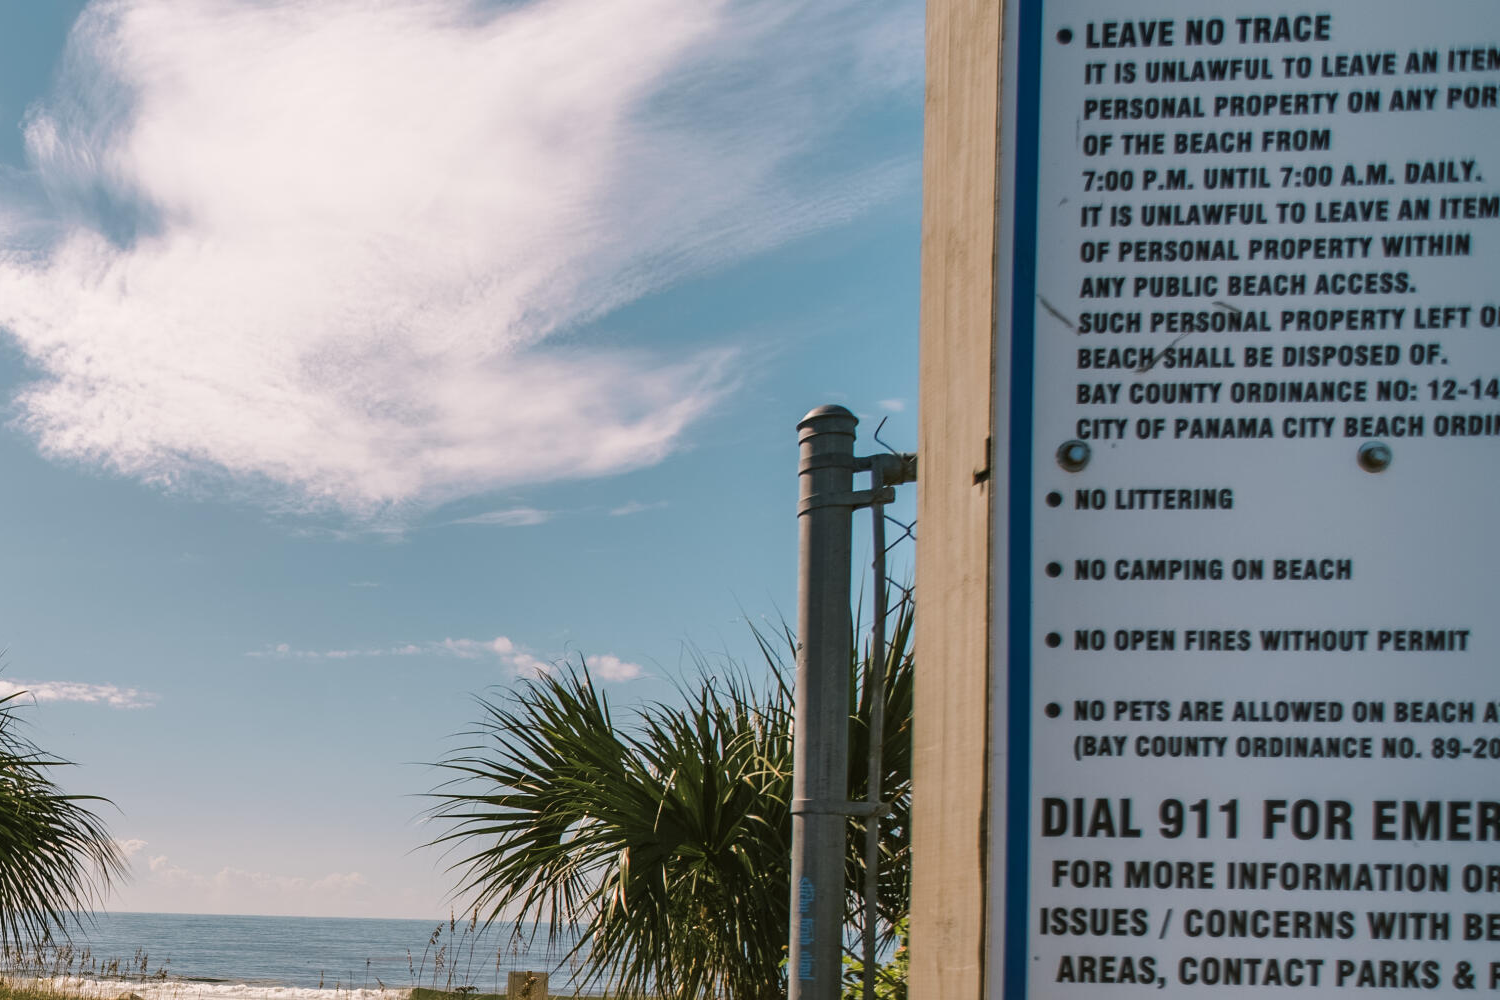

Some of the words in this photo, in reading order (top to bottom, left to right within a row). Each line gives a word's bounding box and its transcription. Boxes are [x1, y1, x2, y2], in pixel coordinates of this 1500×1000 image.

[1086, 20, 1174, 48] LEAVE
[1186, 18, 1225, 45] NO
[1236, 14, 1332, 42] TRACE
[1083, 134, 1113, 156] OF
[1121, 133, 1165, 154] THE
[1174, 131, 1253, 153] BEACH
[1262, 129, 1332, 151] FROM
[1082, 170, 1134, 191] 7:00
[1142, 168, 1194, 190] P.M.
[1204, 167, 1271, 189] UNTIL
[1280, 165, 1334, 187] 7:00
[1341, 163, 1395, 185] A.M.
[1405, 160, 1482, 183] DAILY.
[1081, 204, 1103, 226] IT
[1110, 205, 1132, 226] IS
[1141, 204, 1268, 225] UNLAWFUL
[1276, 202, 1307, 223] TO
[1315, 200, 1390, 222] LEAVE
[1398, 198, 1431, 220] AN
[1440, 197, 1500, 218] ITEM
[1080, 241, 1110, 262] OF
[1118, 240, 1240, 261] PERSONAL
[1248, 237, 1373, 259] PROPERTY
[1382, 234, 1471, 256] WITHIN
[1080, 277, 1126, 297] ANY
[1134, 276, 1218, 297] PUBLIC
[1228, 274, 1307, 296] BEACH
[1314, 272, 1416, 294] ACCESS.
[1077, 346, 1155, 370] BEACH
[1162, 346, 1236, 369] SHALL
[1244, 345, 1273, 368] BE
[1282, 344, 1401, 367] DISPOSED
[1409, 343, 1448, 367] OF.
[1075, 489, 1107, 510] NO
[1115, 489, 1234, 509] LITTERING
[1075, 559, 1106, 580] NO
[1114, 559, 1224, 580] CAMPING
[1232, 559, 1264, 580] ON
[1273, 559, 1352, 580] BEACH
[1074, 630, 1106, 650] NO
[1114, 630, 1176, 650] OPEN
[1185, 630, 1252, 650] FIRES
[1260, 630, 1369, 651] WITHOUT
[1378, 630, 1470, 650] PERMIT
[1042, 798, 1142, 837] DIAL
[1159, 799, 1239, 838] 911
[1263, 799, 1353, 839] FOR
[1052, 860, 1112, 888] FOR
[1124, 861, 1215, 888] MORE
[1227, 863, 1450, 891] INFORMATION
